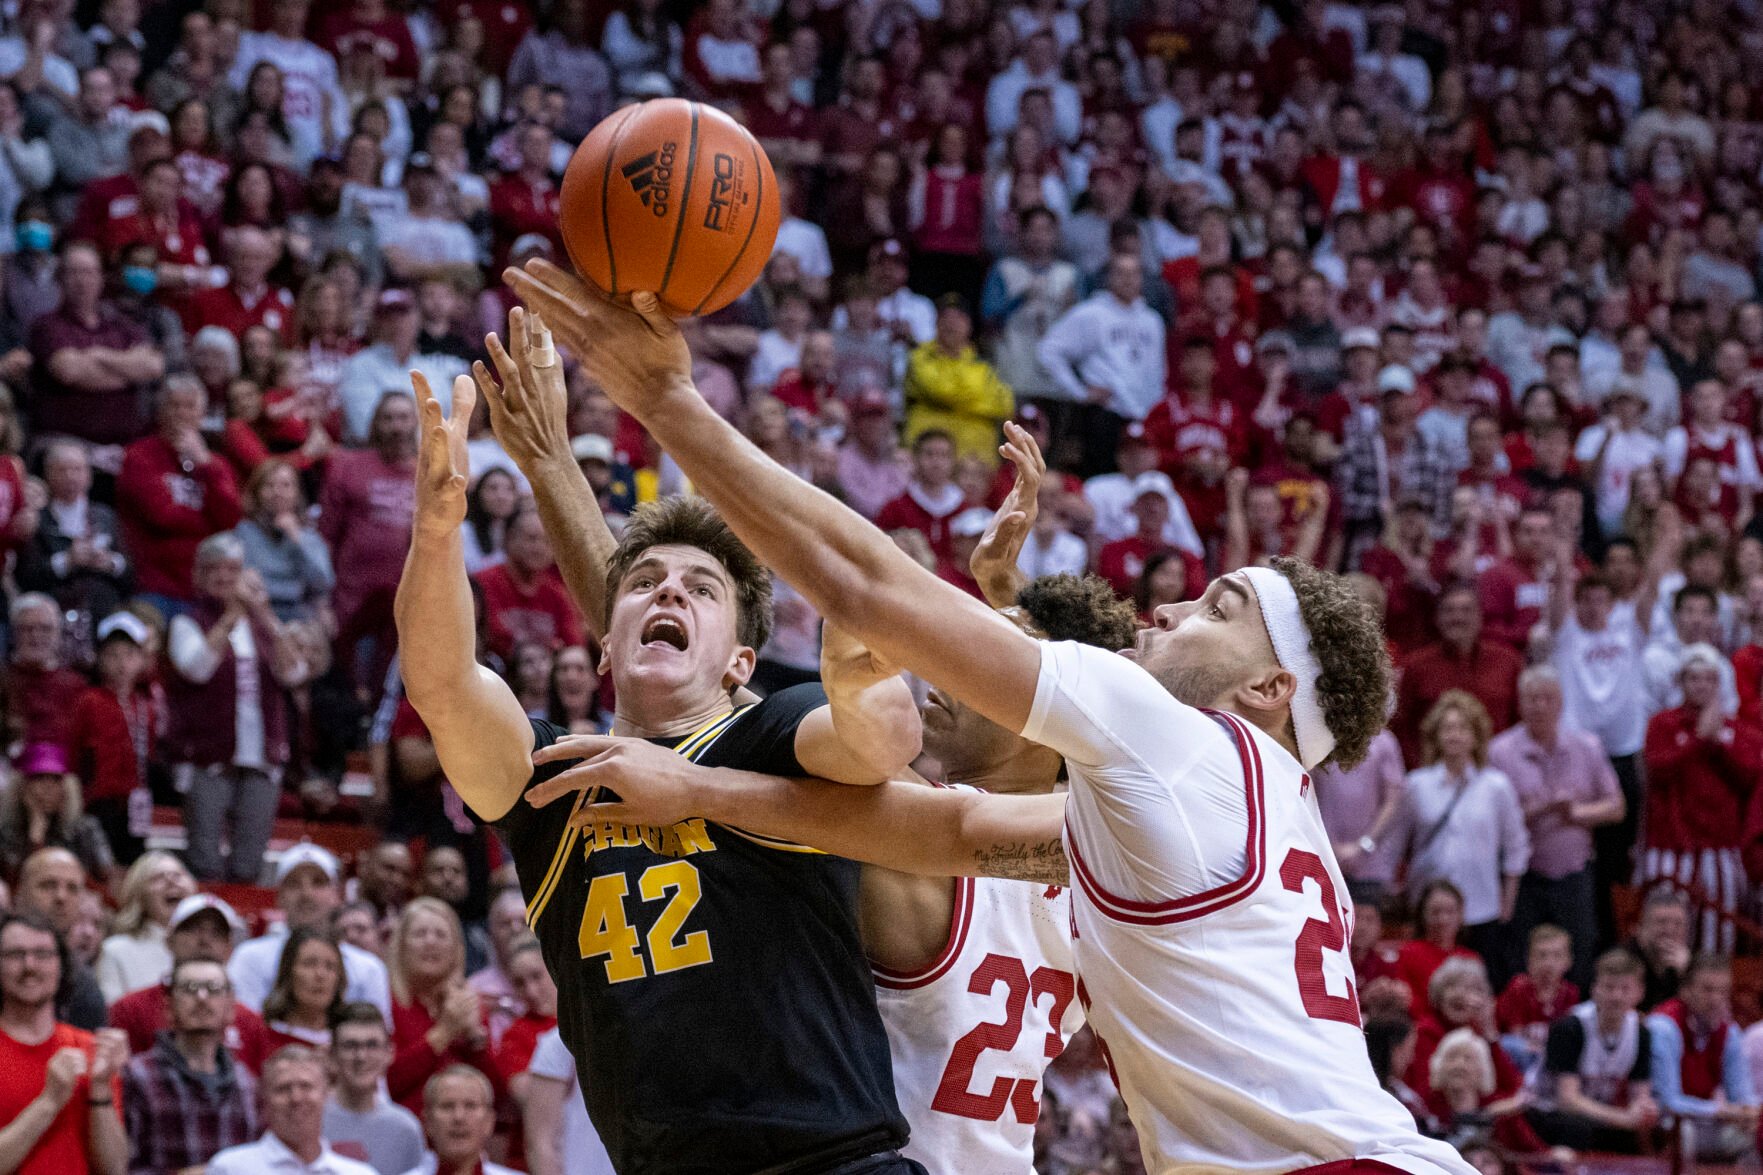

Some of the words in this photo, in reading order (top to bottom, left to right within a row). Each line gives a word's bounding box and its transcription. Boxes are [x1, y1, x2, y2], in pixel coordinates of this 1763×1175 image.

[651, 142, 677, 217] adidas
[703, 153, 733, 231] PRO
[578, 859, 713, 984] 42
[1279, 847, 1363, 1031] 2
[930, 953, 1075, 1125] 23
